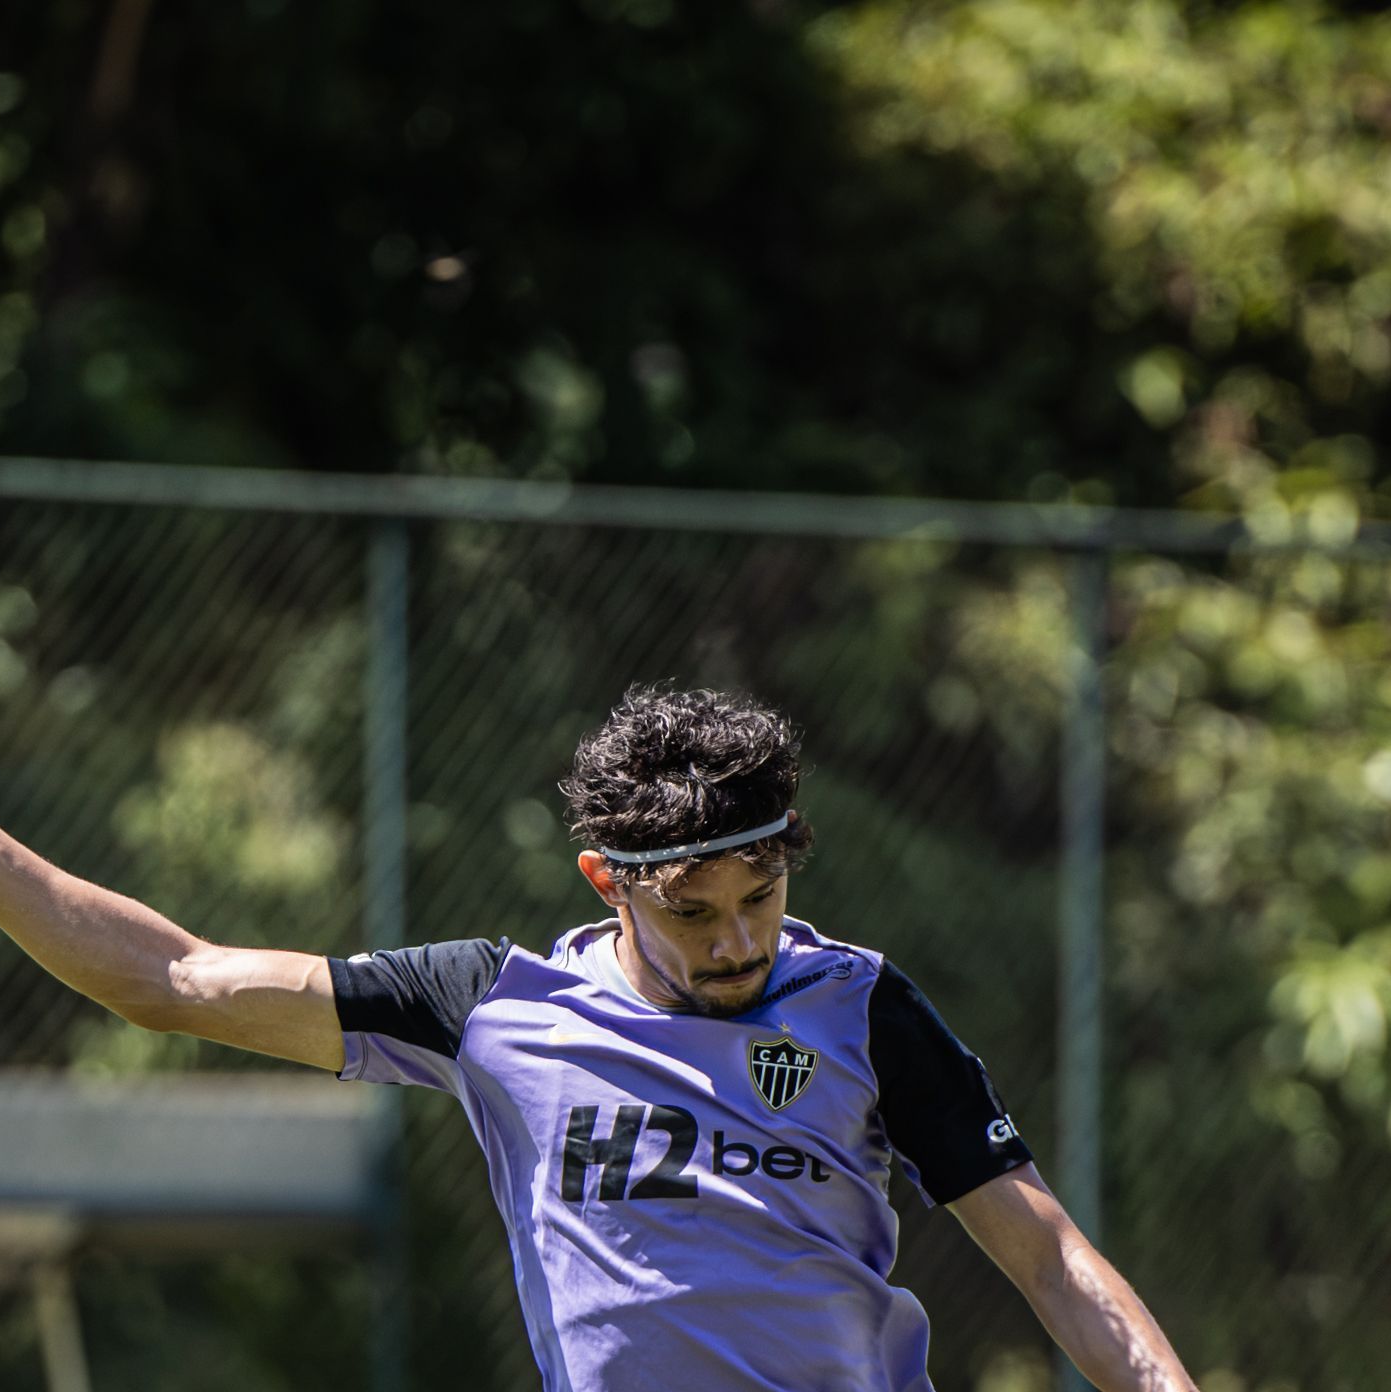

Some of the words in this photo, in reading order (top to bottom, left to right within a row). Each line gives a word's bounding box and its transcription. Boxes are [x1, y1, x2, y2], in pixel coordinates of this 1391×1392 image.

[759, 1049, 809, 1067] CAM
[561, 1103, 699, 1202] H2
[712, 1130, 830, 1183] bet
